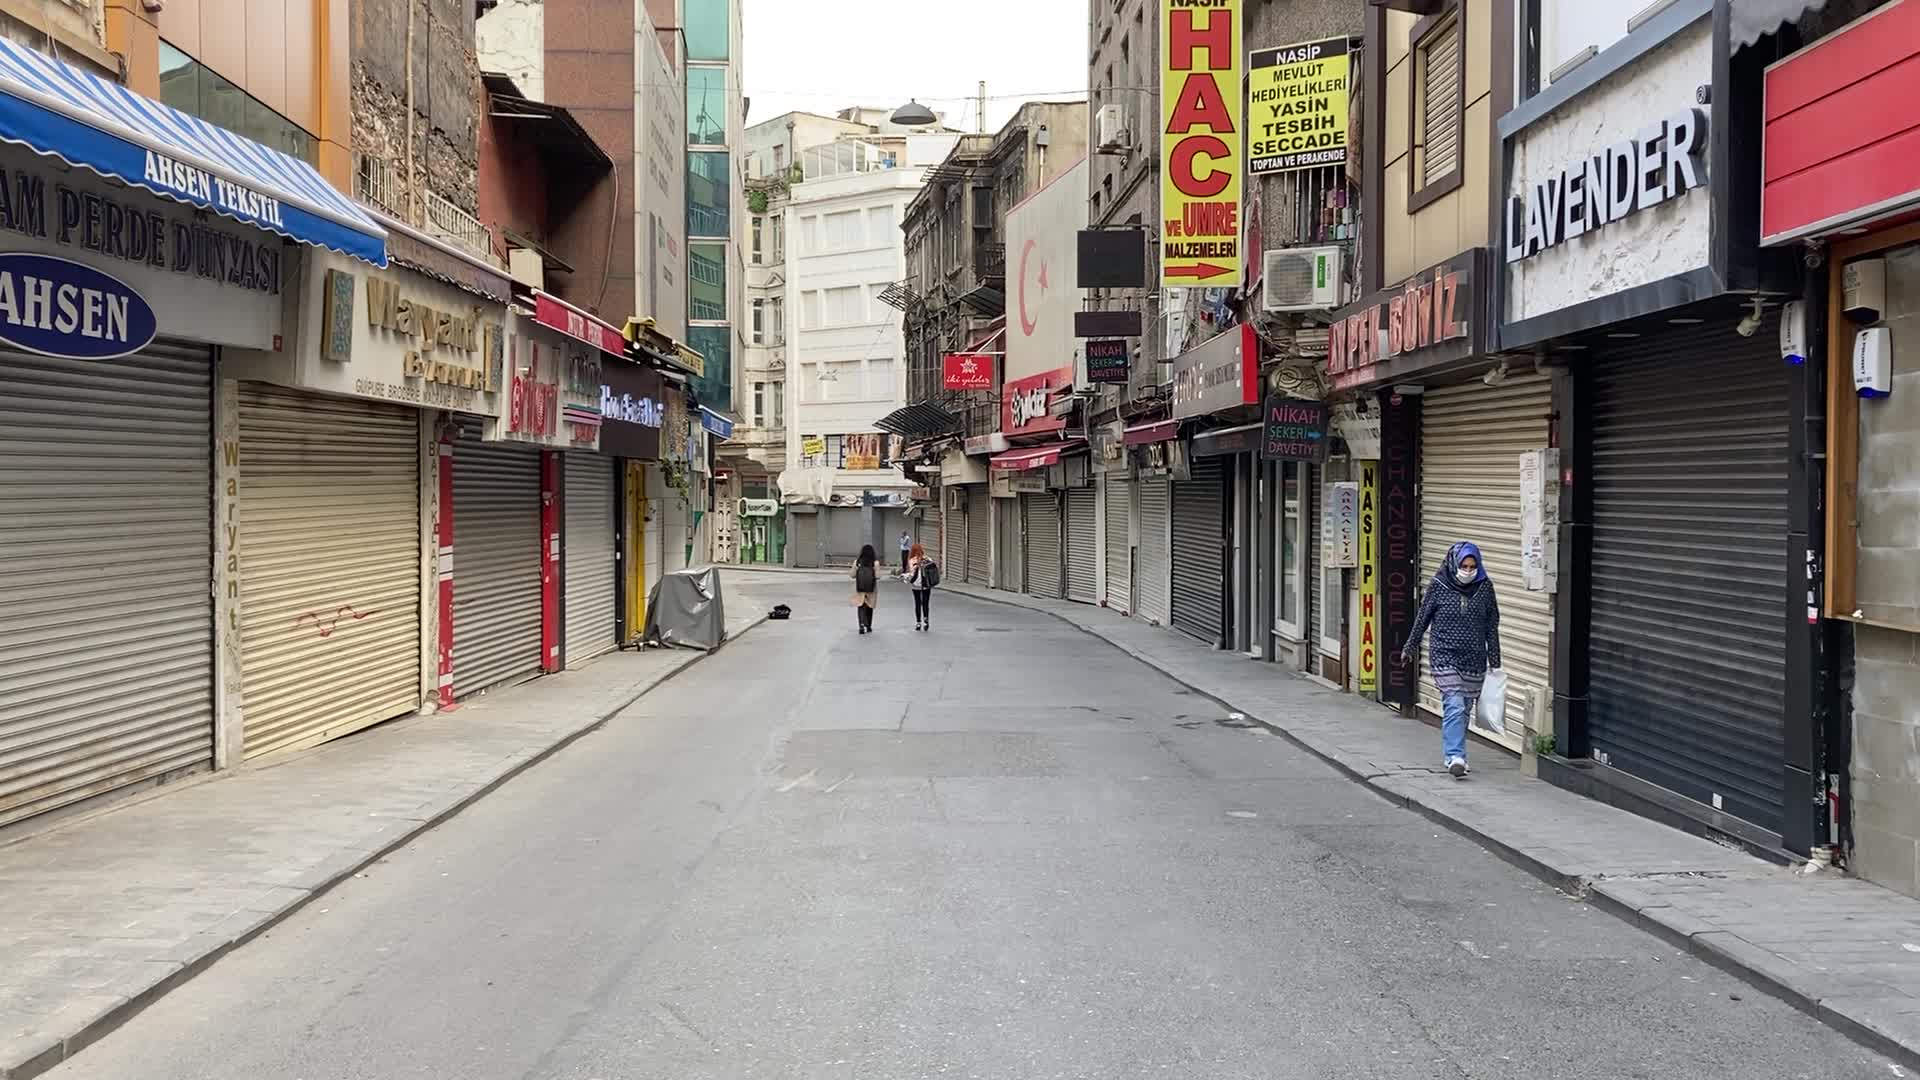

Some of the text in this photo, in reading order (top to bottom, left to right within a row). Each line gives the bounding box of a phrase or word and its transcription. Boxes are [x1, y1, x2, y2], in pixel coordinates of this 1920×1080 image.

[1275, 45, 1321, 65] NASİP
[1273, 63, 1324, 83] MEVLÜT
[1251, 74, 1347, 104] HEDİYELİKLERİ
[1270, 97, 1328, 118] YASİN
[1263, 115, 1335, 137] TESBİH
[1252, 130, 1345, 155] SECCADE
[1252, 149, 1345, 171] TOPTAN VE PERAKENDE
[144, 150, 284, 228] AHSEN TEKSTİL
[1506, 105, 1708, 263] LAVENDER
[1164, 202, 1237, 237] VE UMRE
[56, 183, 166, 269] PERDE
[171, 207, 282, 296] DÜNYASI
[1165, 238, 1237, 259] MALZEMELERİ
[0, 271, 129, 343] AHSEN
[1271, 404, 1321, 425] NİKAH
[223, 441, 239, 631] Waryant
[1362, 467, 1374, 584] NASİP
[1362, 593, 1374, 673] HAC
